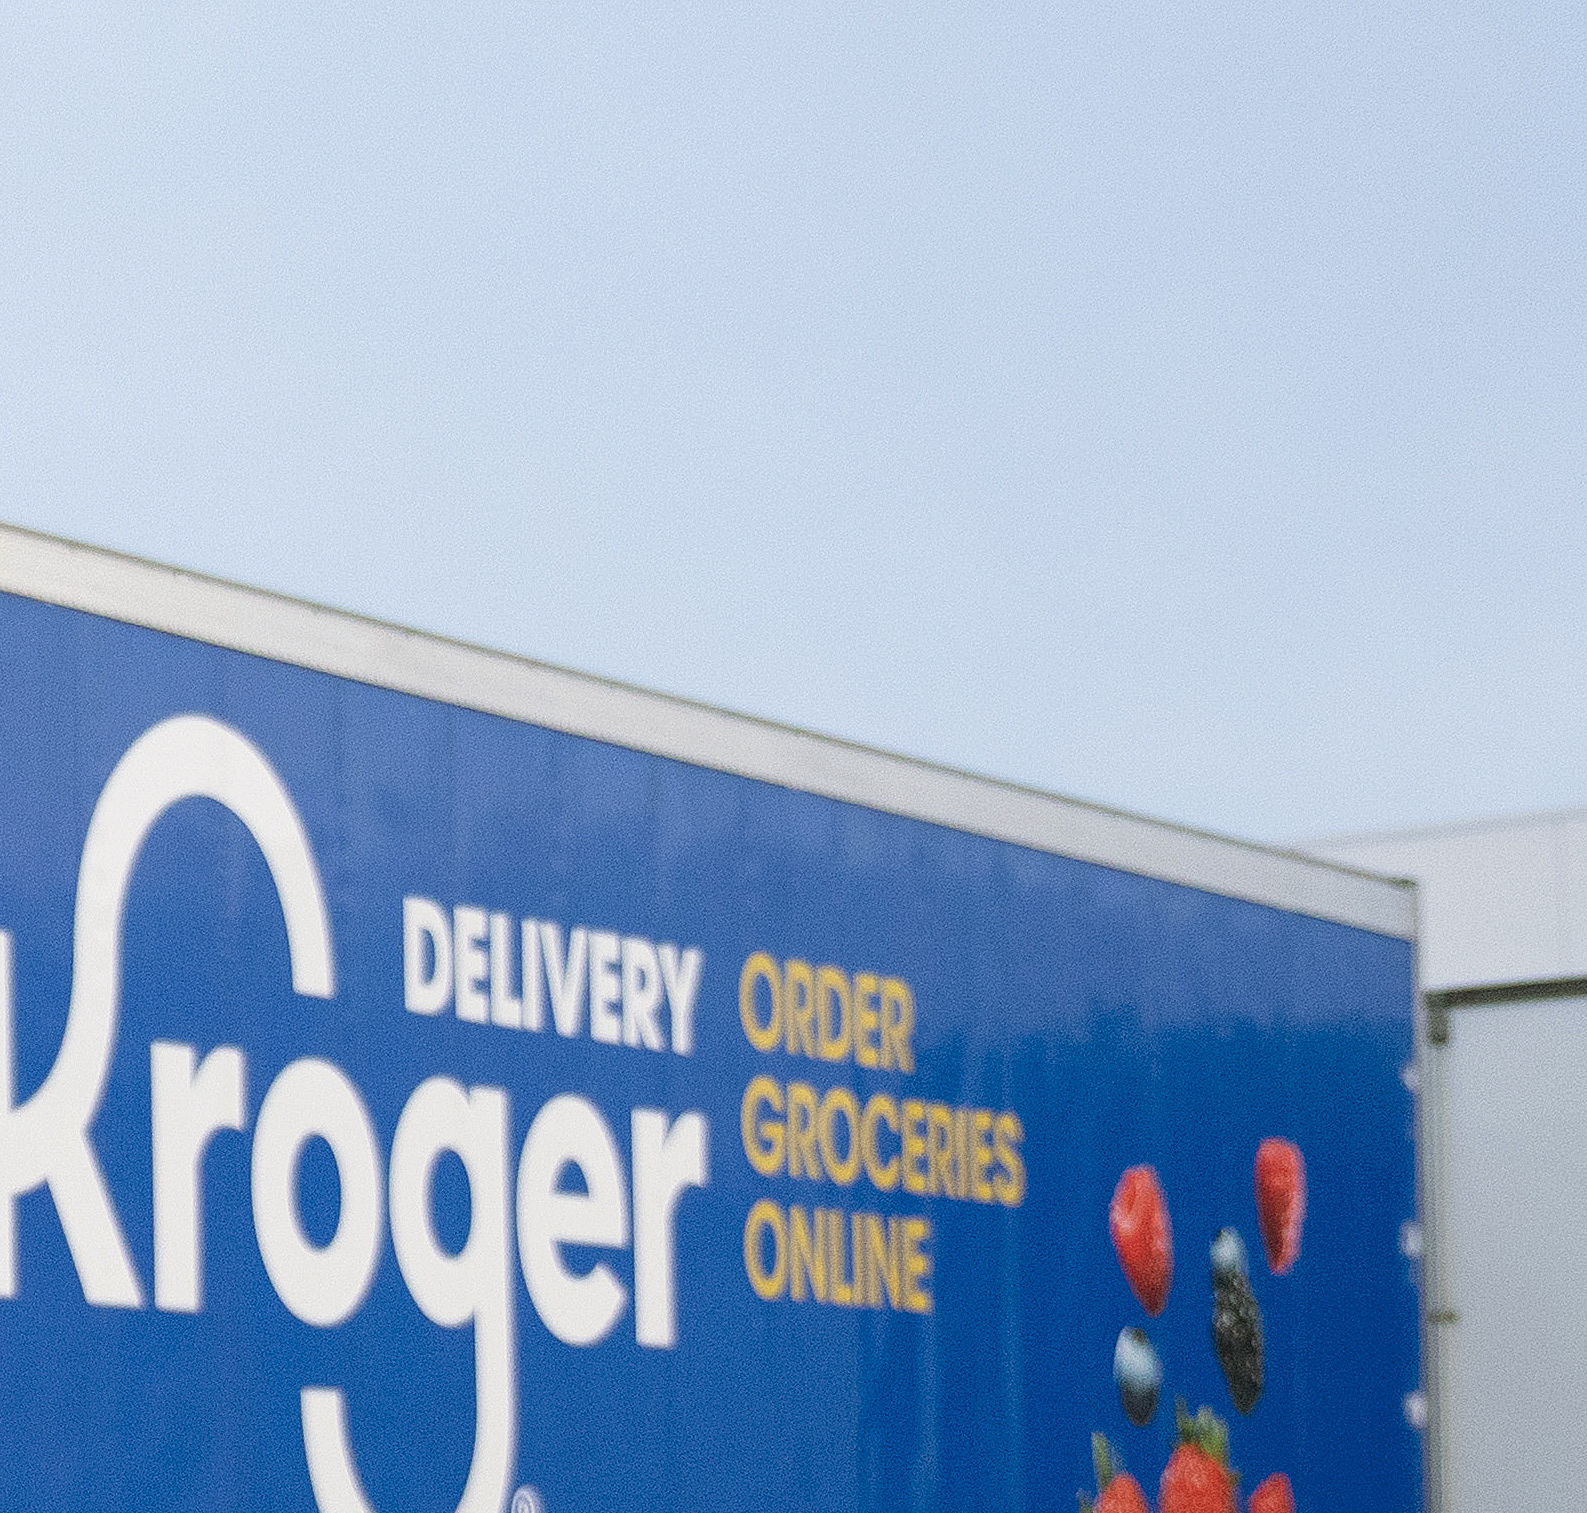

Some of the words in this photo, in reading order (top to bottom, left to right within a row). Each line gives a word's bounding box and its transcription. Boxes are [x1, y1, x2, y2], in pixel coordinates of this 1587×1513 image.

[402, 896, 705, 1056] DELIVERY
[738, 951, 916, 1074] ORDER
[740, 1075, 1026, 1207] GROCERIES
[744, 1199, 933, 1315] ONLINE
